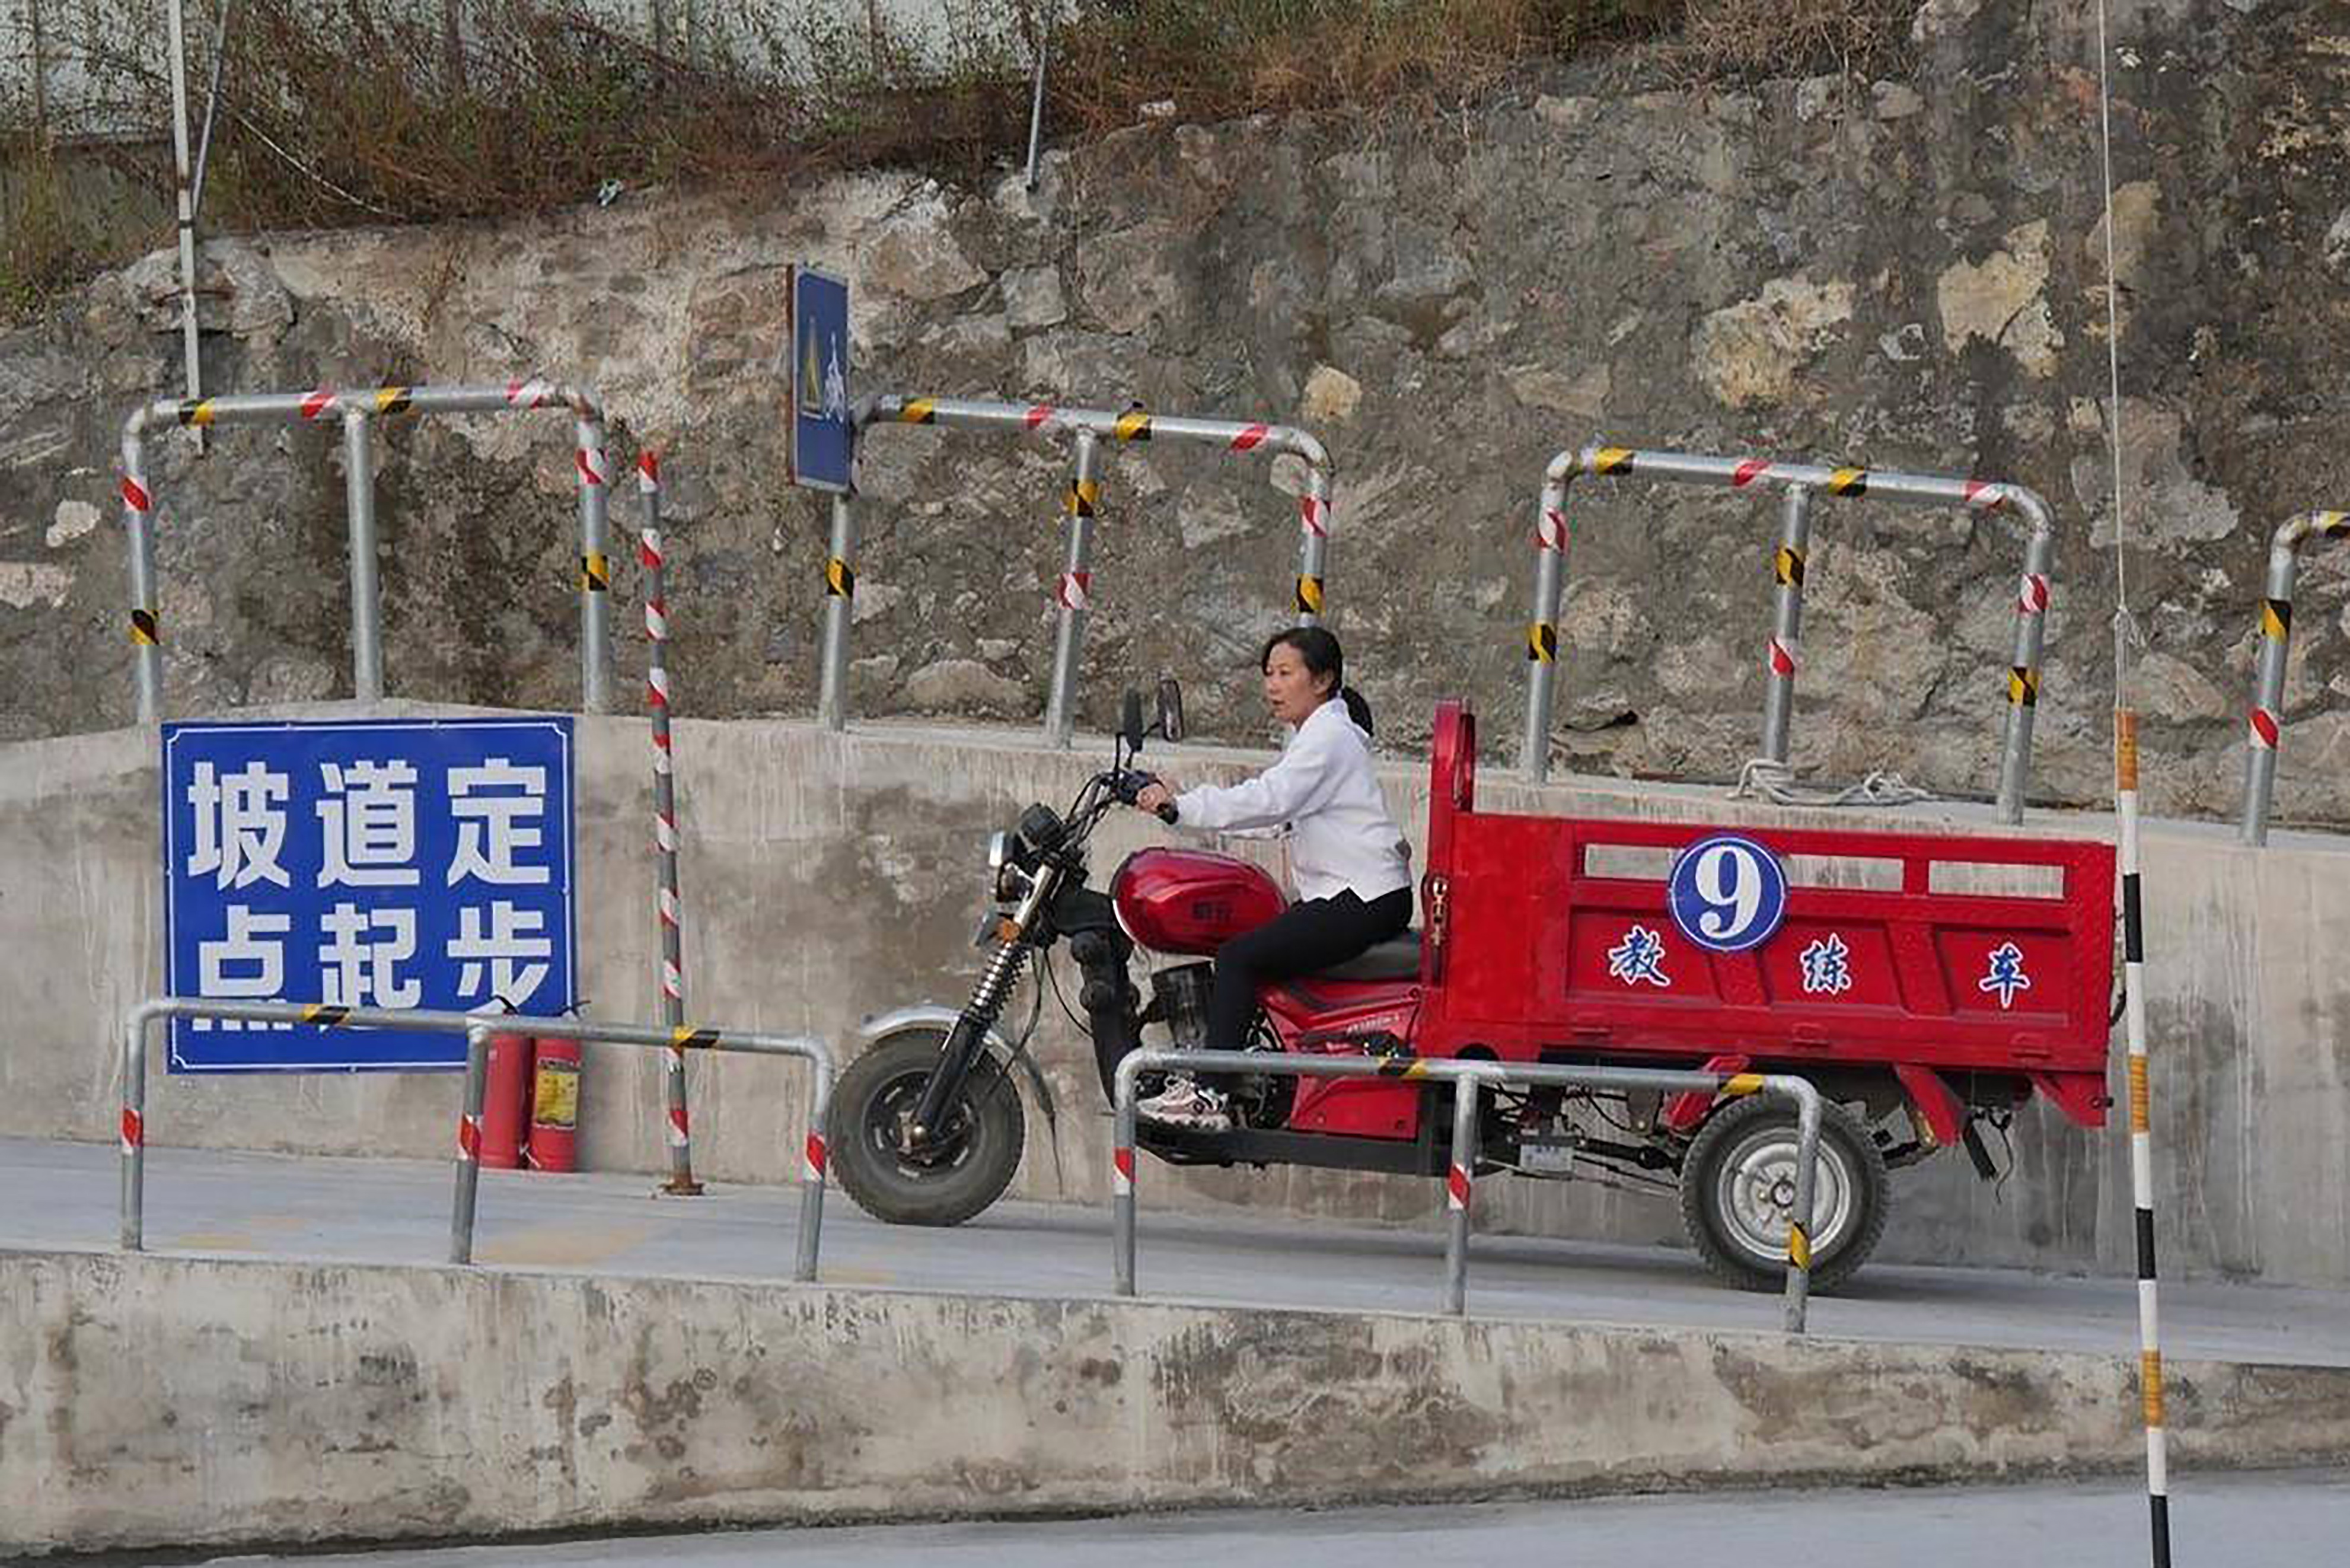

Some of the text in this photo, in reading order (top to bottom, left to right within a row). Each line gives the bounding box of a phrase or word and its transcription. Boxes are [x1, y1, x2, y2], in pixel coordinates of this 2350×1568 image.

[187, 758, 551, 891] 坡道定
[1695, 845, 1762, 939] 9
[192, 901, 552, 1031] 点起步
